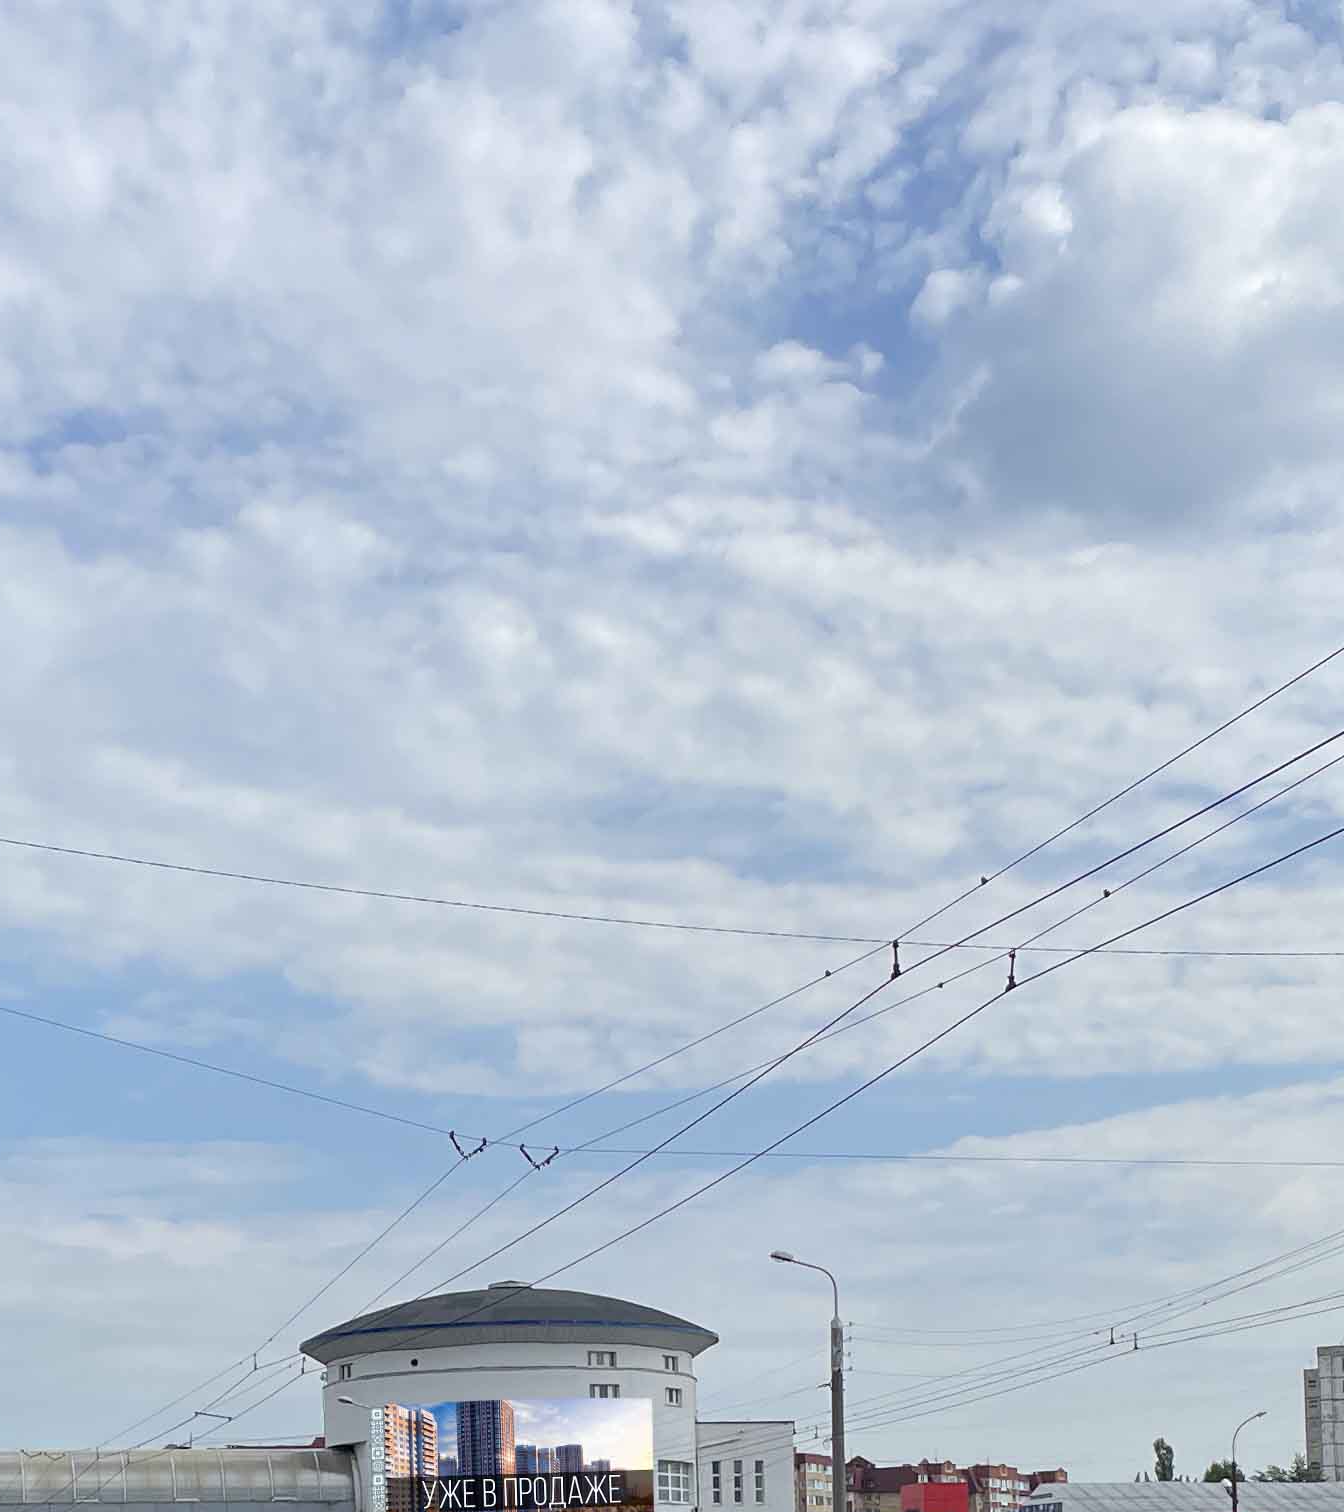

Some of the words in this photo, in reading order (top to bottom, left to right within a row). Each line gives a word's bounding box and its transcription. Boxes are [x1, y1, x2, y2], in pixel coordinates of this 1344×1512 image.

[422, 1479, 476, 1509] УЖЕ
[482, 1478, 497, 1507] В
[503, 1474, 622, 1510] ПРОДАЖЕ
